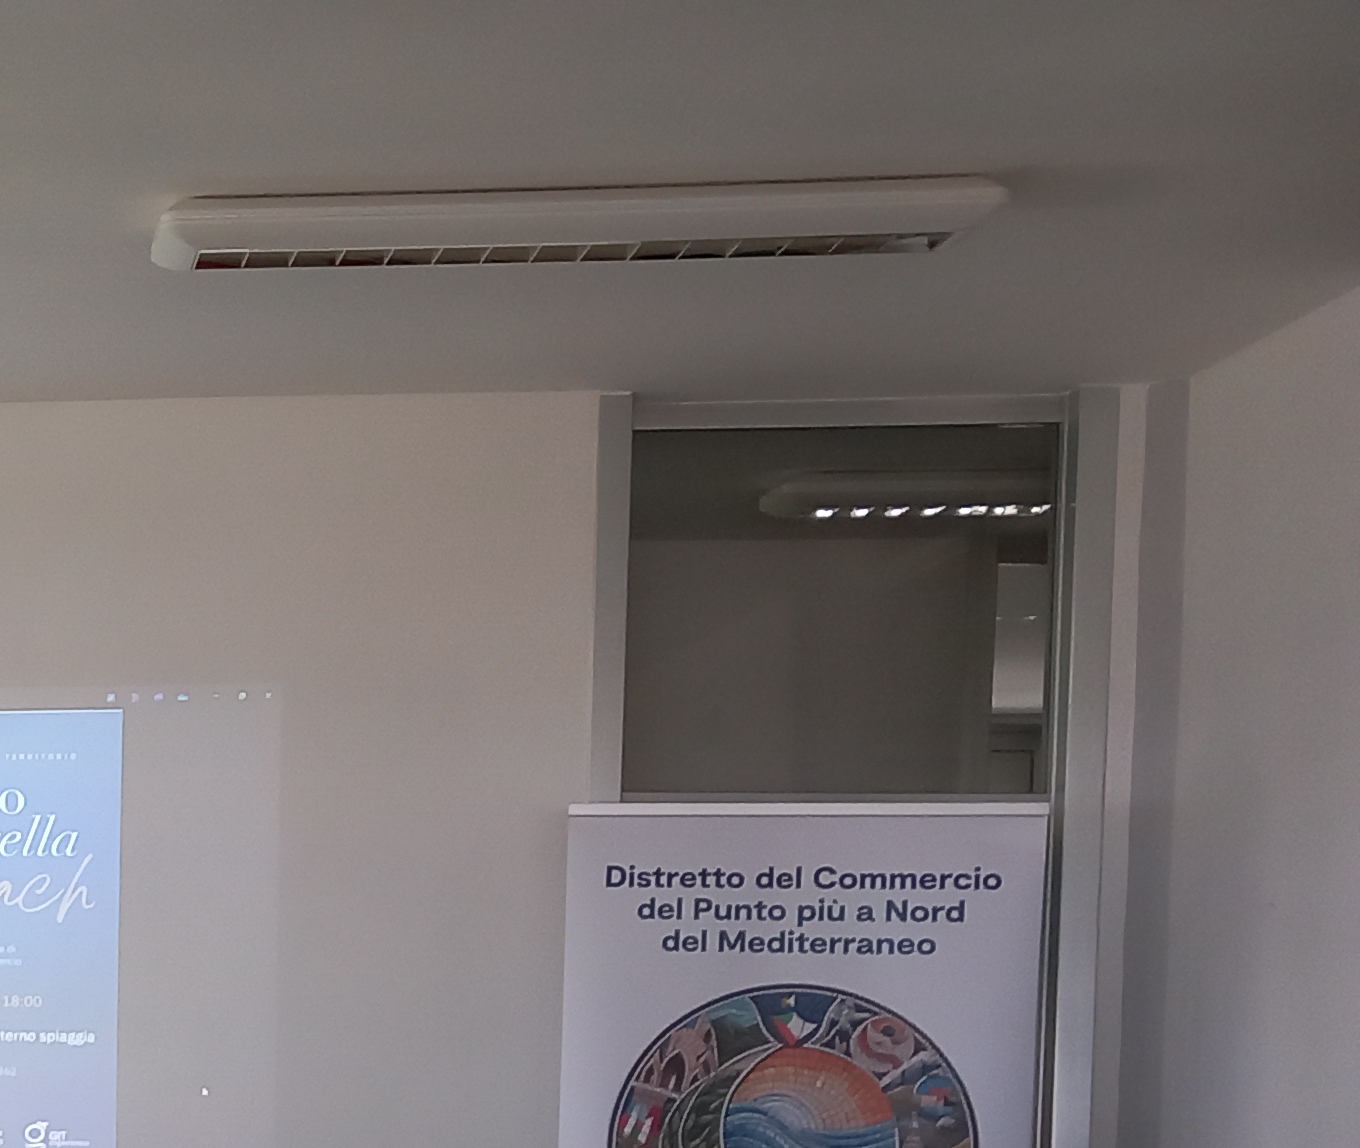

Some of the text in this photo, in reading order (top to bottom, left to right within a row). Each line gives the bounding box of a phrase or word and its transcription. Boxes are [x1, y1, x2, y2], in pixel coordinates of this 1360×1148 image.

[605, 864, 1003, 891] Distretto del Commercio
[637, 896, 966, 928] del Punto più a Nord
[661, 928, 937, 956] del Mediterraneo
[3, 995, 43, 1008] 18:00
[39, 1031, 96, 1046] spiaggia
